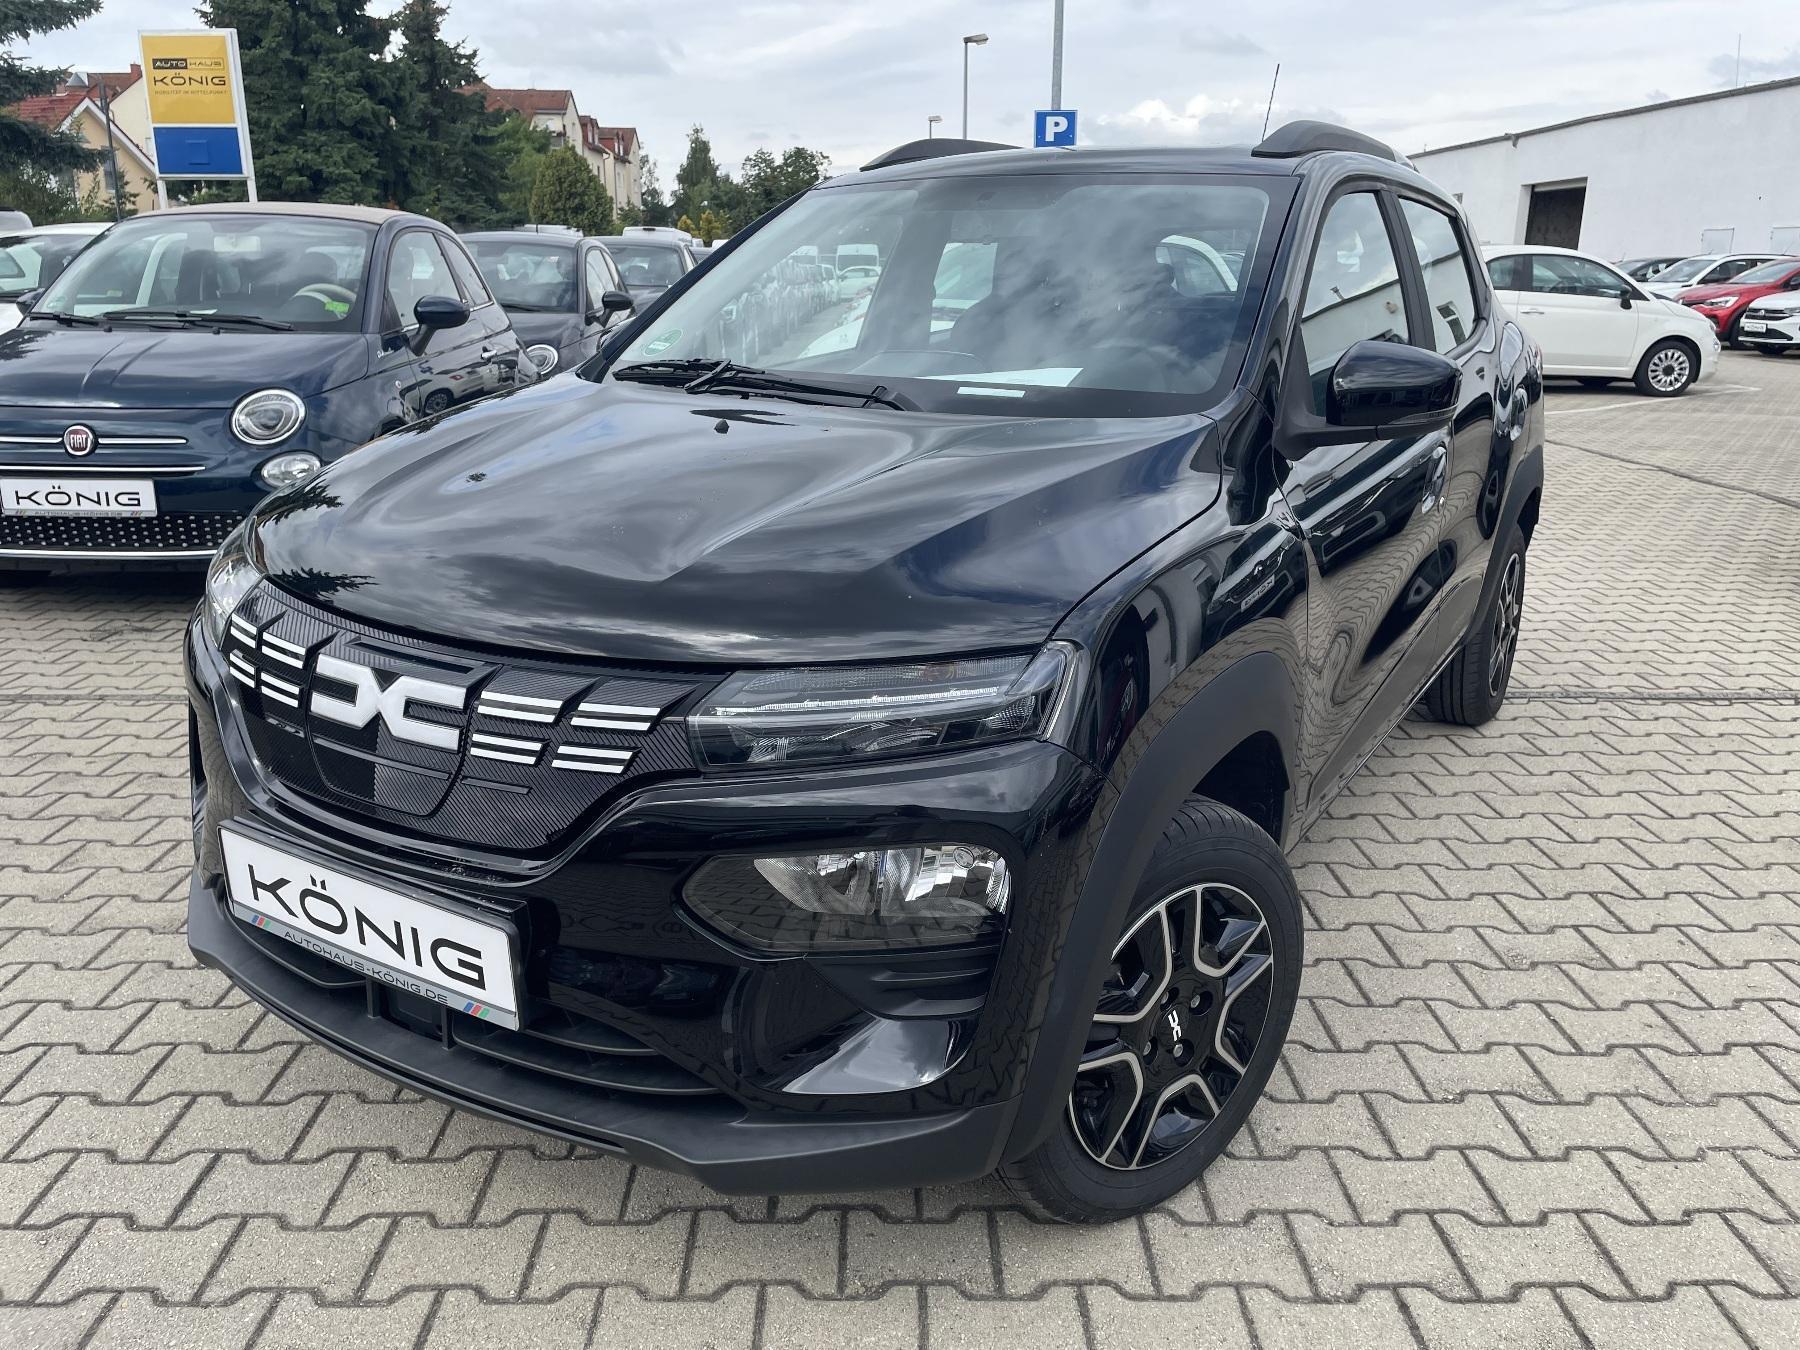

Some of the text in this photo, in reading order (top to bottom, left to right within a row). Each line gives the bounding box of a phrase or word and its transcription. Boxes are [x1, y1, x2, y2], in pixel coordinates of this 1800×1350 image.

[153, 72, 226, 86] KÖNIG
[1045, 116, 1069, 142] P
[70, 434, 87, 449] FIAT
[14, 484, 141, 507] KÖNIG
[248, 864, 486, 991] KÖNIG
[284, 931, 449, 1004] AUTOHAUS-KÖNIG.DE
